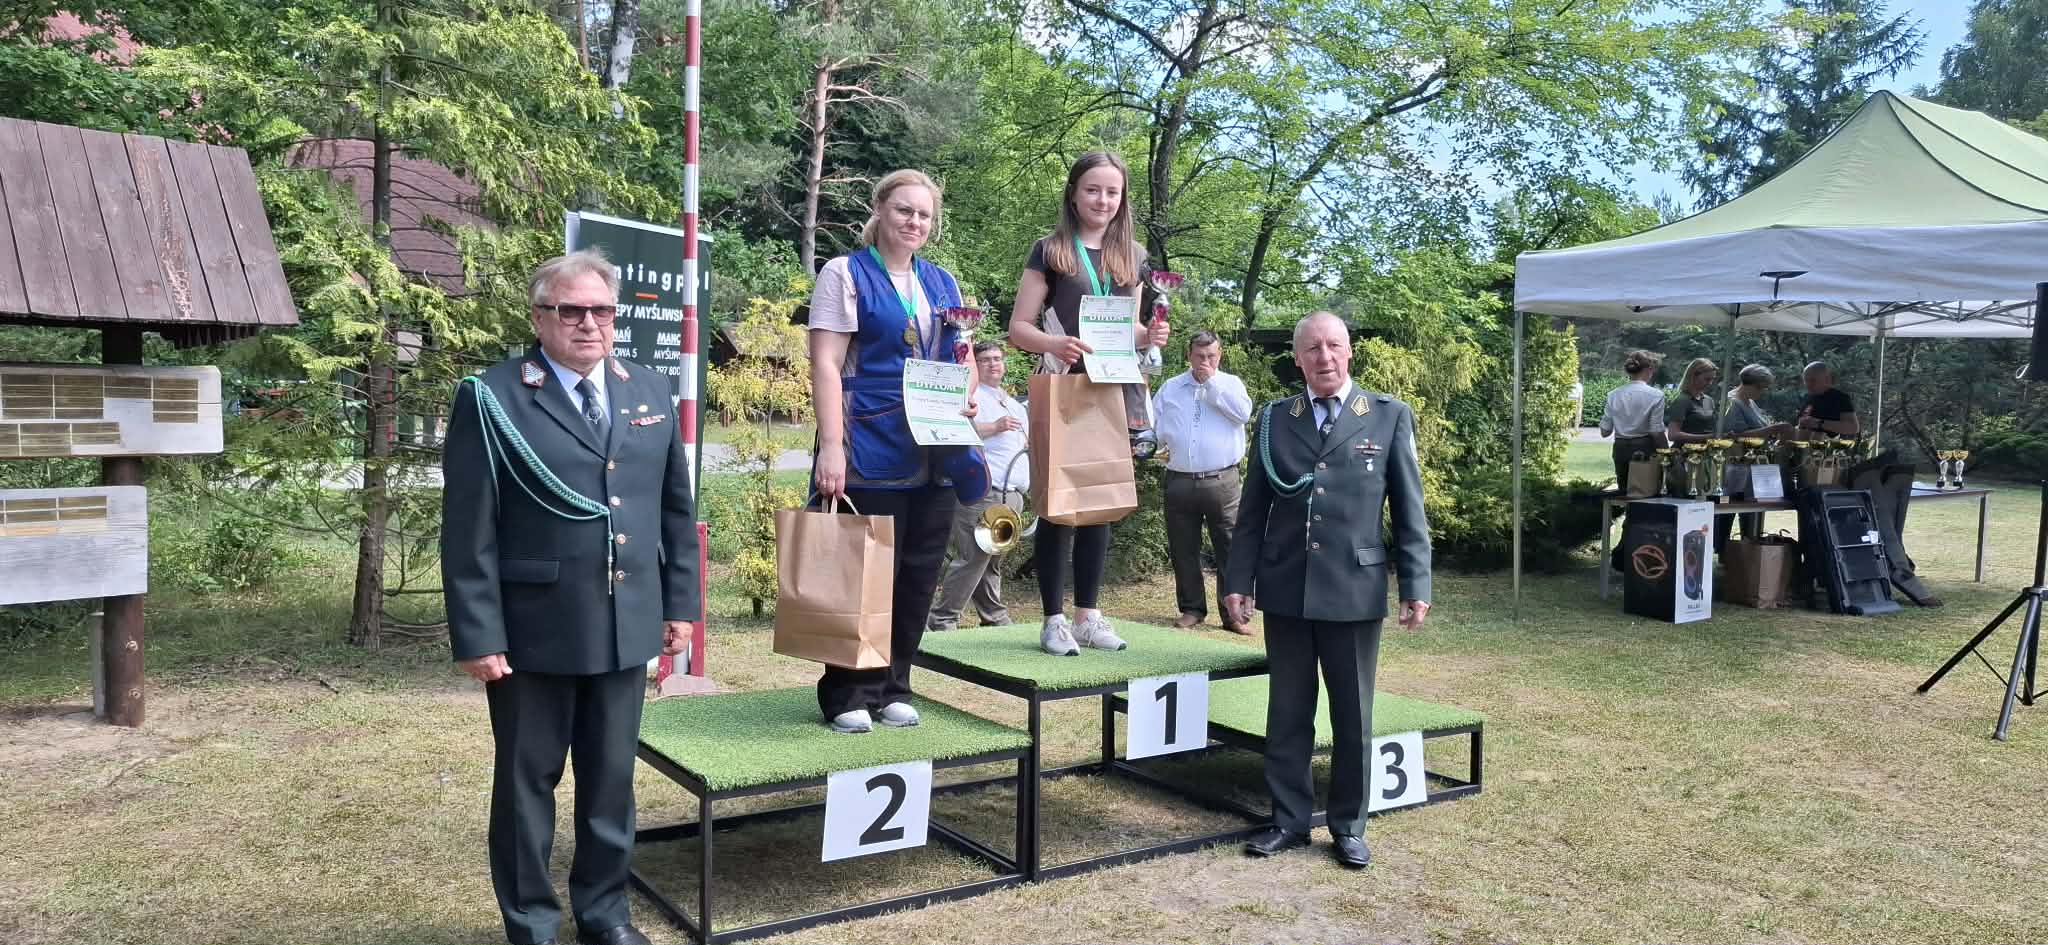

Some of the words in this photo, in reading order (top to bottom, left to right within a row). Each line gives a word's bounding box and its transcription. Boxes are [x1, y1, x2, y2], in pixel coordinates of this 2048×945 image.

[614, 264, 709, 293] ntingpl
[632, 347, 638, 358] 5
[1155, 681, 1178, 746] 1
[1380, 742, 1408, 799] 3
[859, 773, 907, 846] 2
